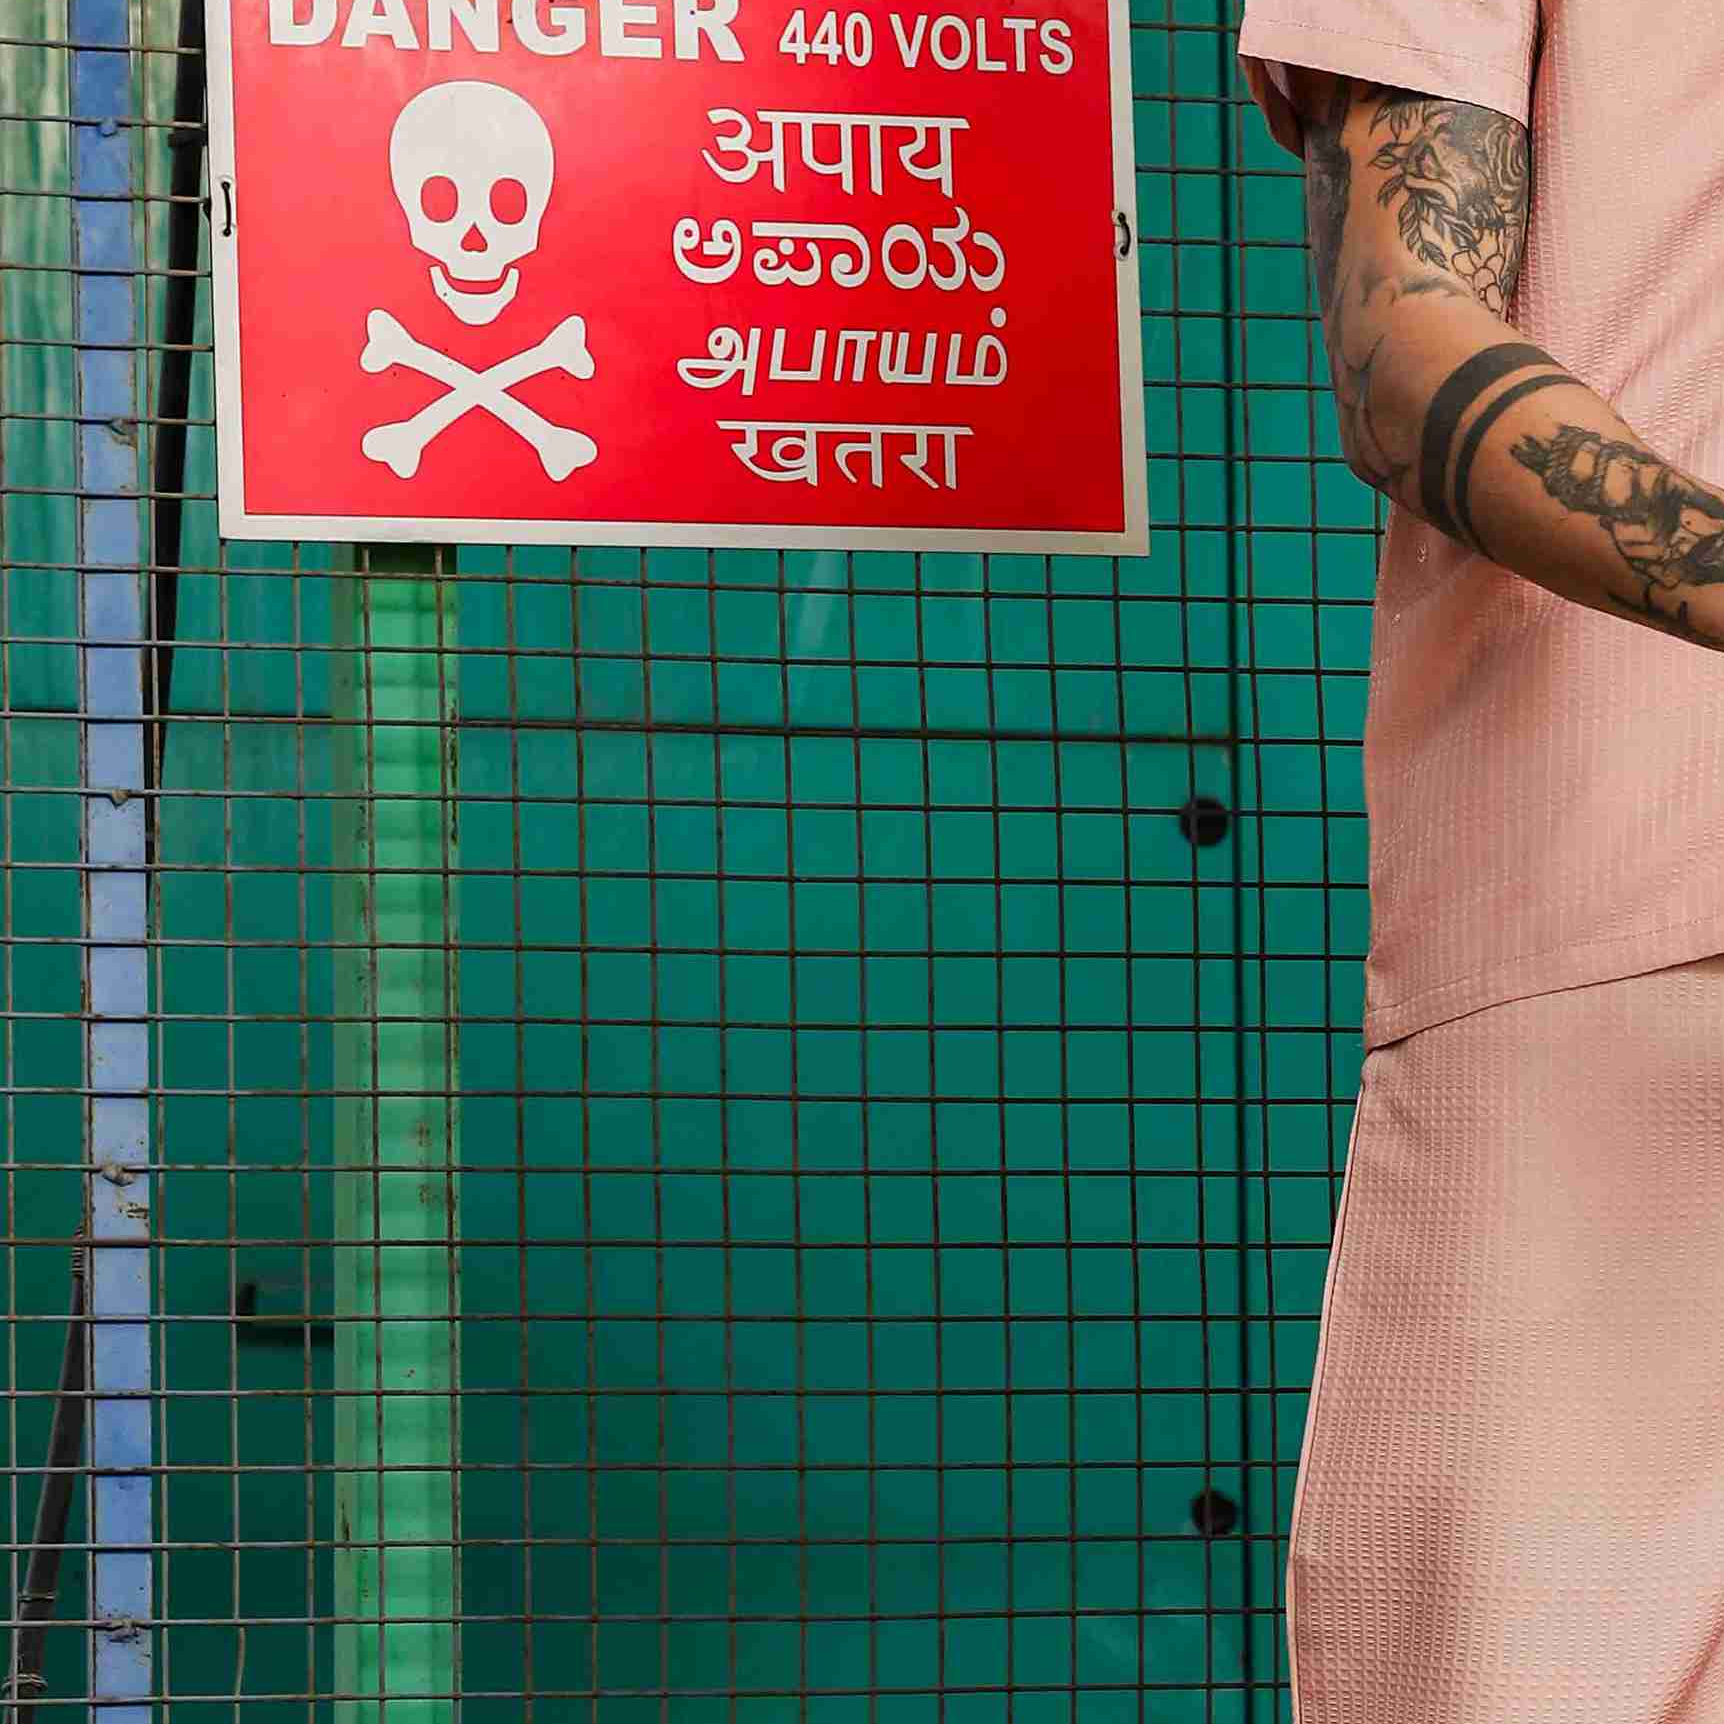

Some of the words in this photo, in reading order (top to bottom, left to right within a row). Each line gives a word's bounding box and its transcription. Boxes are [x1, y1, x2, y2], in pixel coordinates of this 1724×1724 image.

[778, 9, 874, 68] 440
[888, 12, 1074, 74] VOLTS
[701, 107, 970, 198] अपाय
[672, 206, 1006, 292] ಅಪಾಯ
[676, 307, 1008, 396] அபாயம்
[715, 420, 975, 489] खतरा
